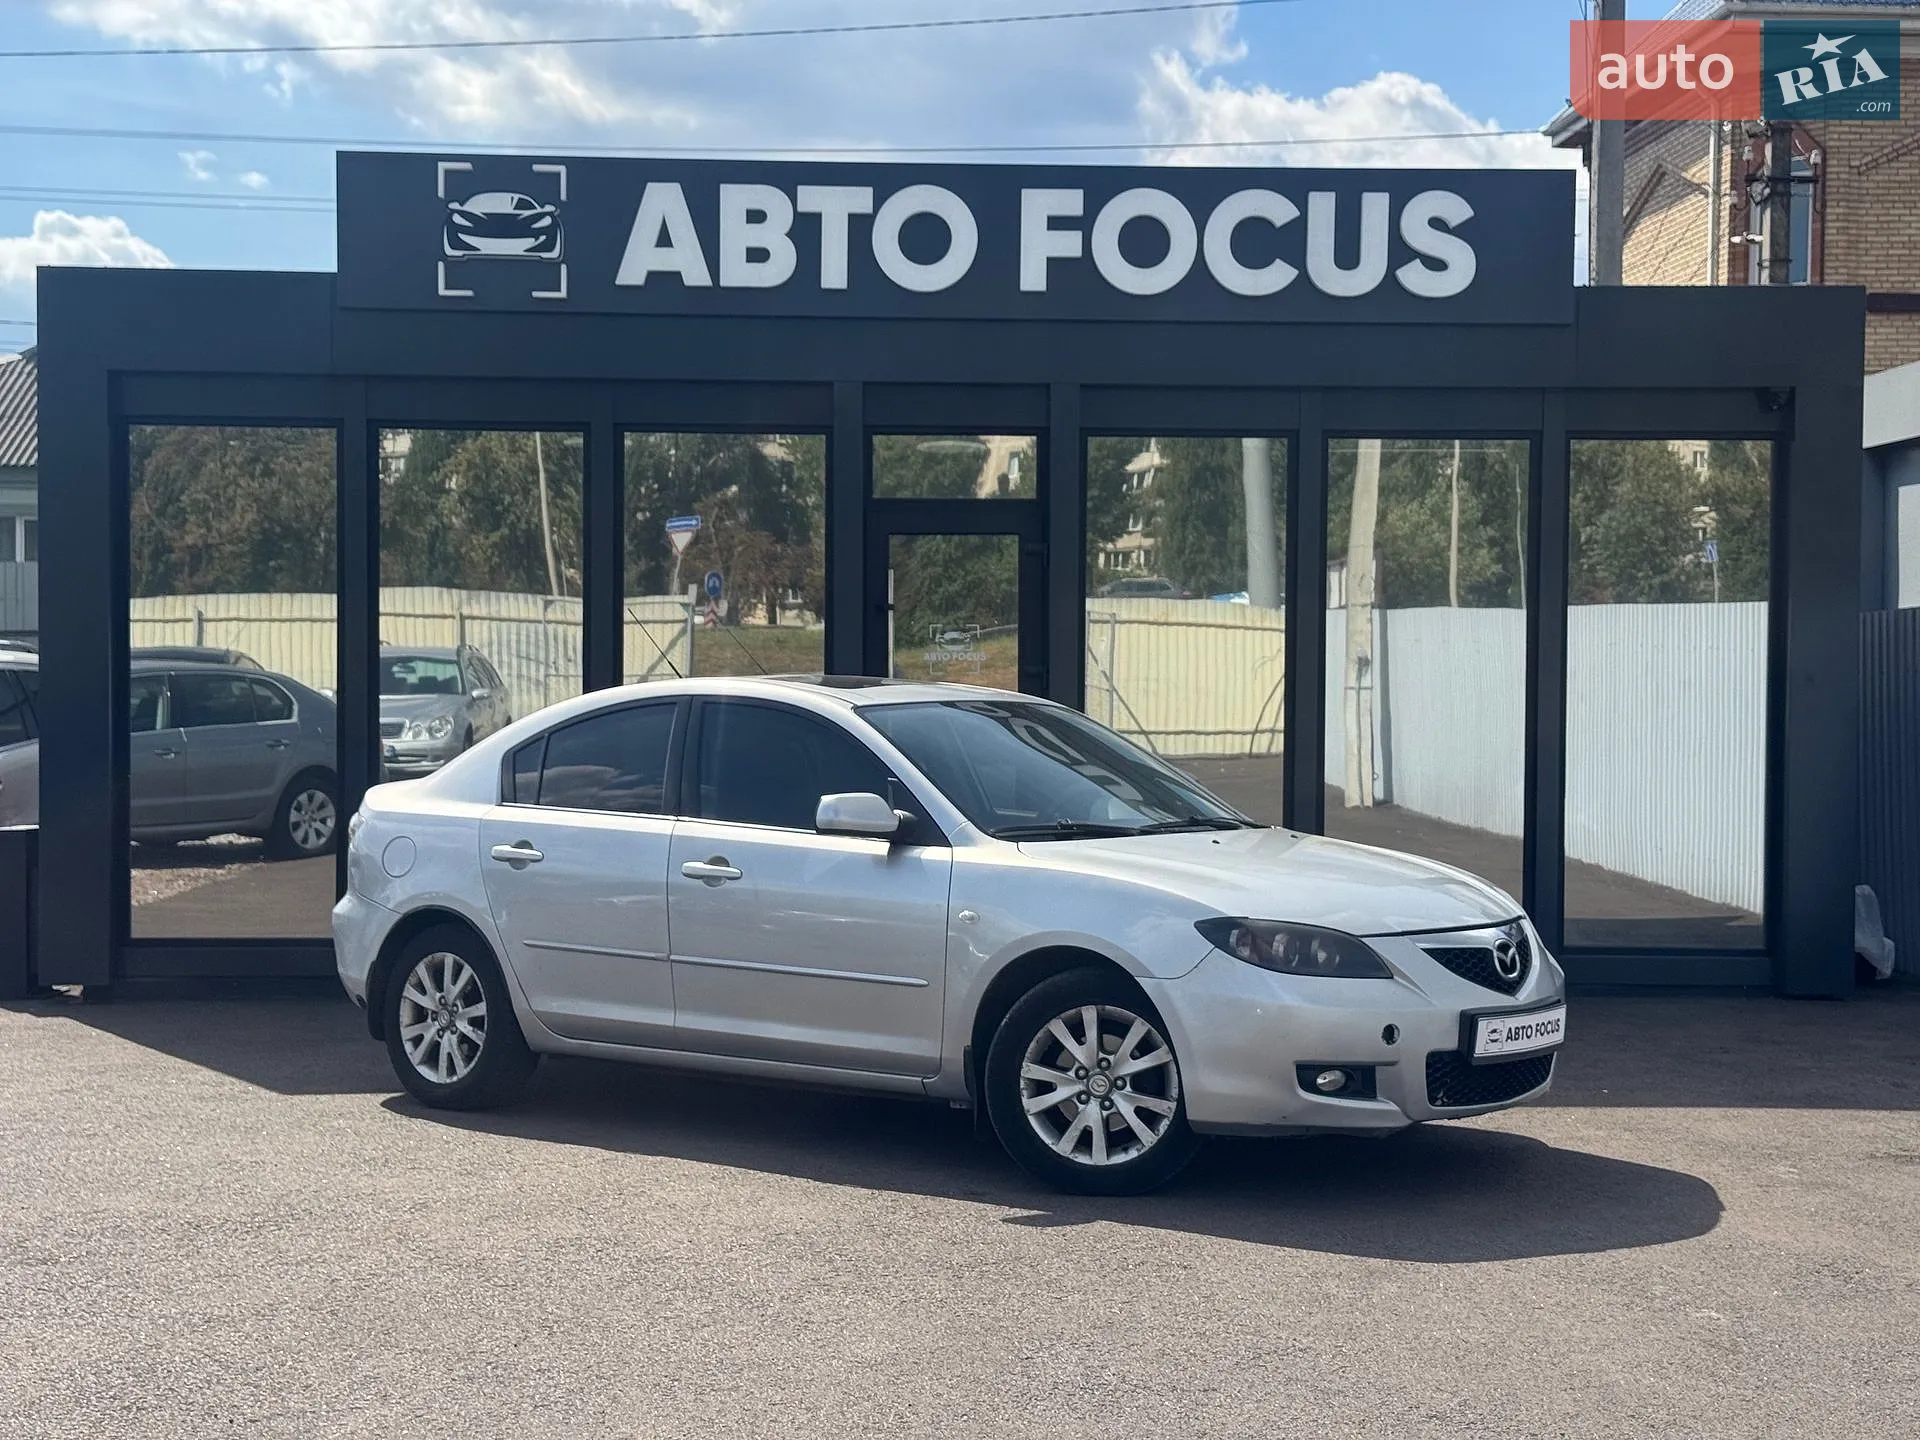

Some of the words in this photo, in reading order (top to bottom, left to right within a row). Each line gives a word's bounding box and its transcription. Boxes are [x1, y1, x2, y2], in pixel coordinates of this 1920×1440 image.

[615, 182, 979, 293] АВТО
[1019, 187, 1477, 299] FOCUS
[1505, 1024, 1533, 1042] АВТО
[1534, 1017, 1560, 1038] FOCUS
